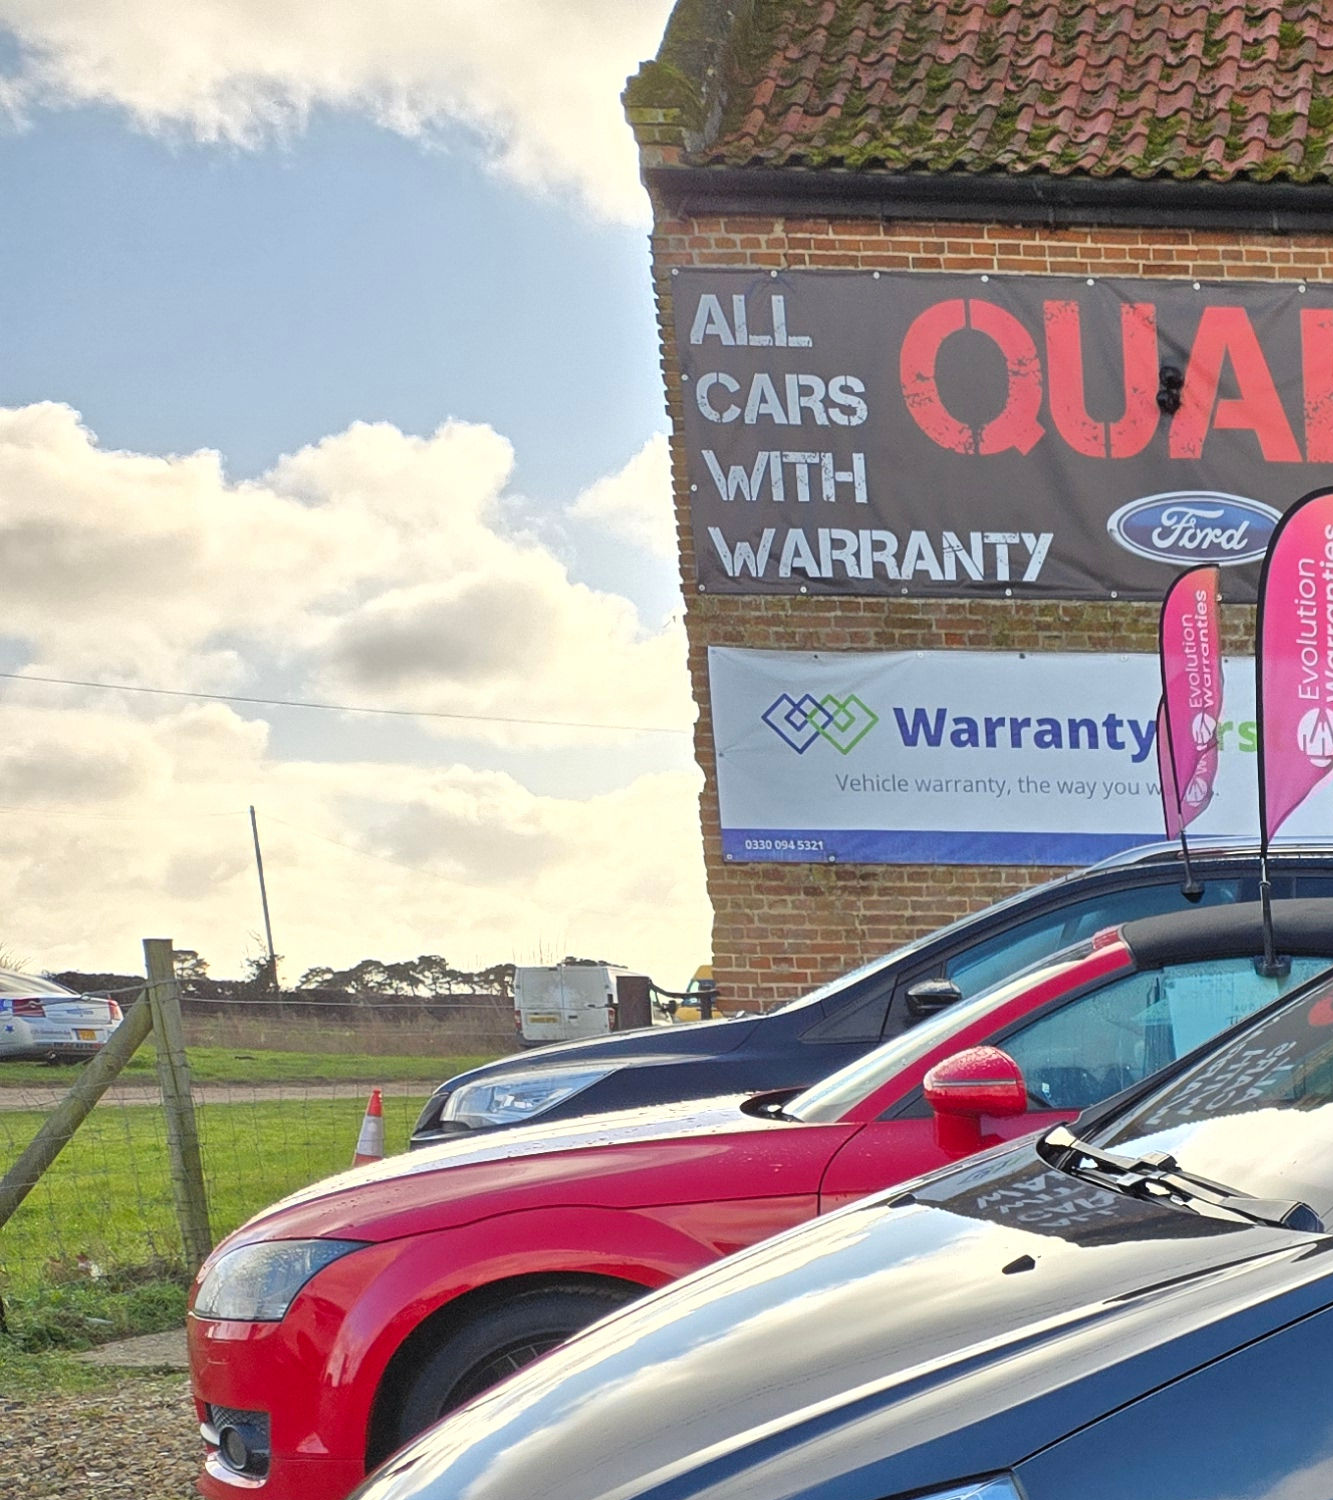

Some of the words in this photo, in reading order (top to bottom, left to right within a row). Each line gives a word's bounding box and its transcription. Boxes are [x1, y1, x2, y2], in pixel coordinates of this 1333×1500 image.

[690, 294, 812, 348] ALL
[696, 372, 868, 427] CARS
[701, 449, 868, 503] WITH
[707, 526, 1054, 582] WARRANTY
[1152, 506, 1249, 551] Ford
[1195, 589, 1214, 708] Warranties
[1294, 558, 1320, 701] Evolution
[1181, 613, 1203, 710] Evolution
[836, 773, 909, 795] Vehicle
[915, 775, 1011, 799] warranty,
[1016, 776, 1050, 796] the
[1056, 780, 1098, 800] way
[1103, 781, 1140, 800] you
[745, 840, 772, 850] 0330
[775, 840, 795, 850] 094
[797, 840, 824, 851] 5321
